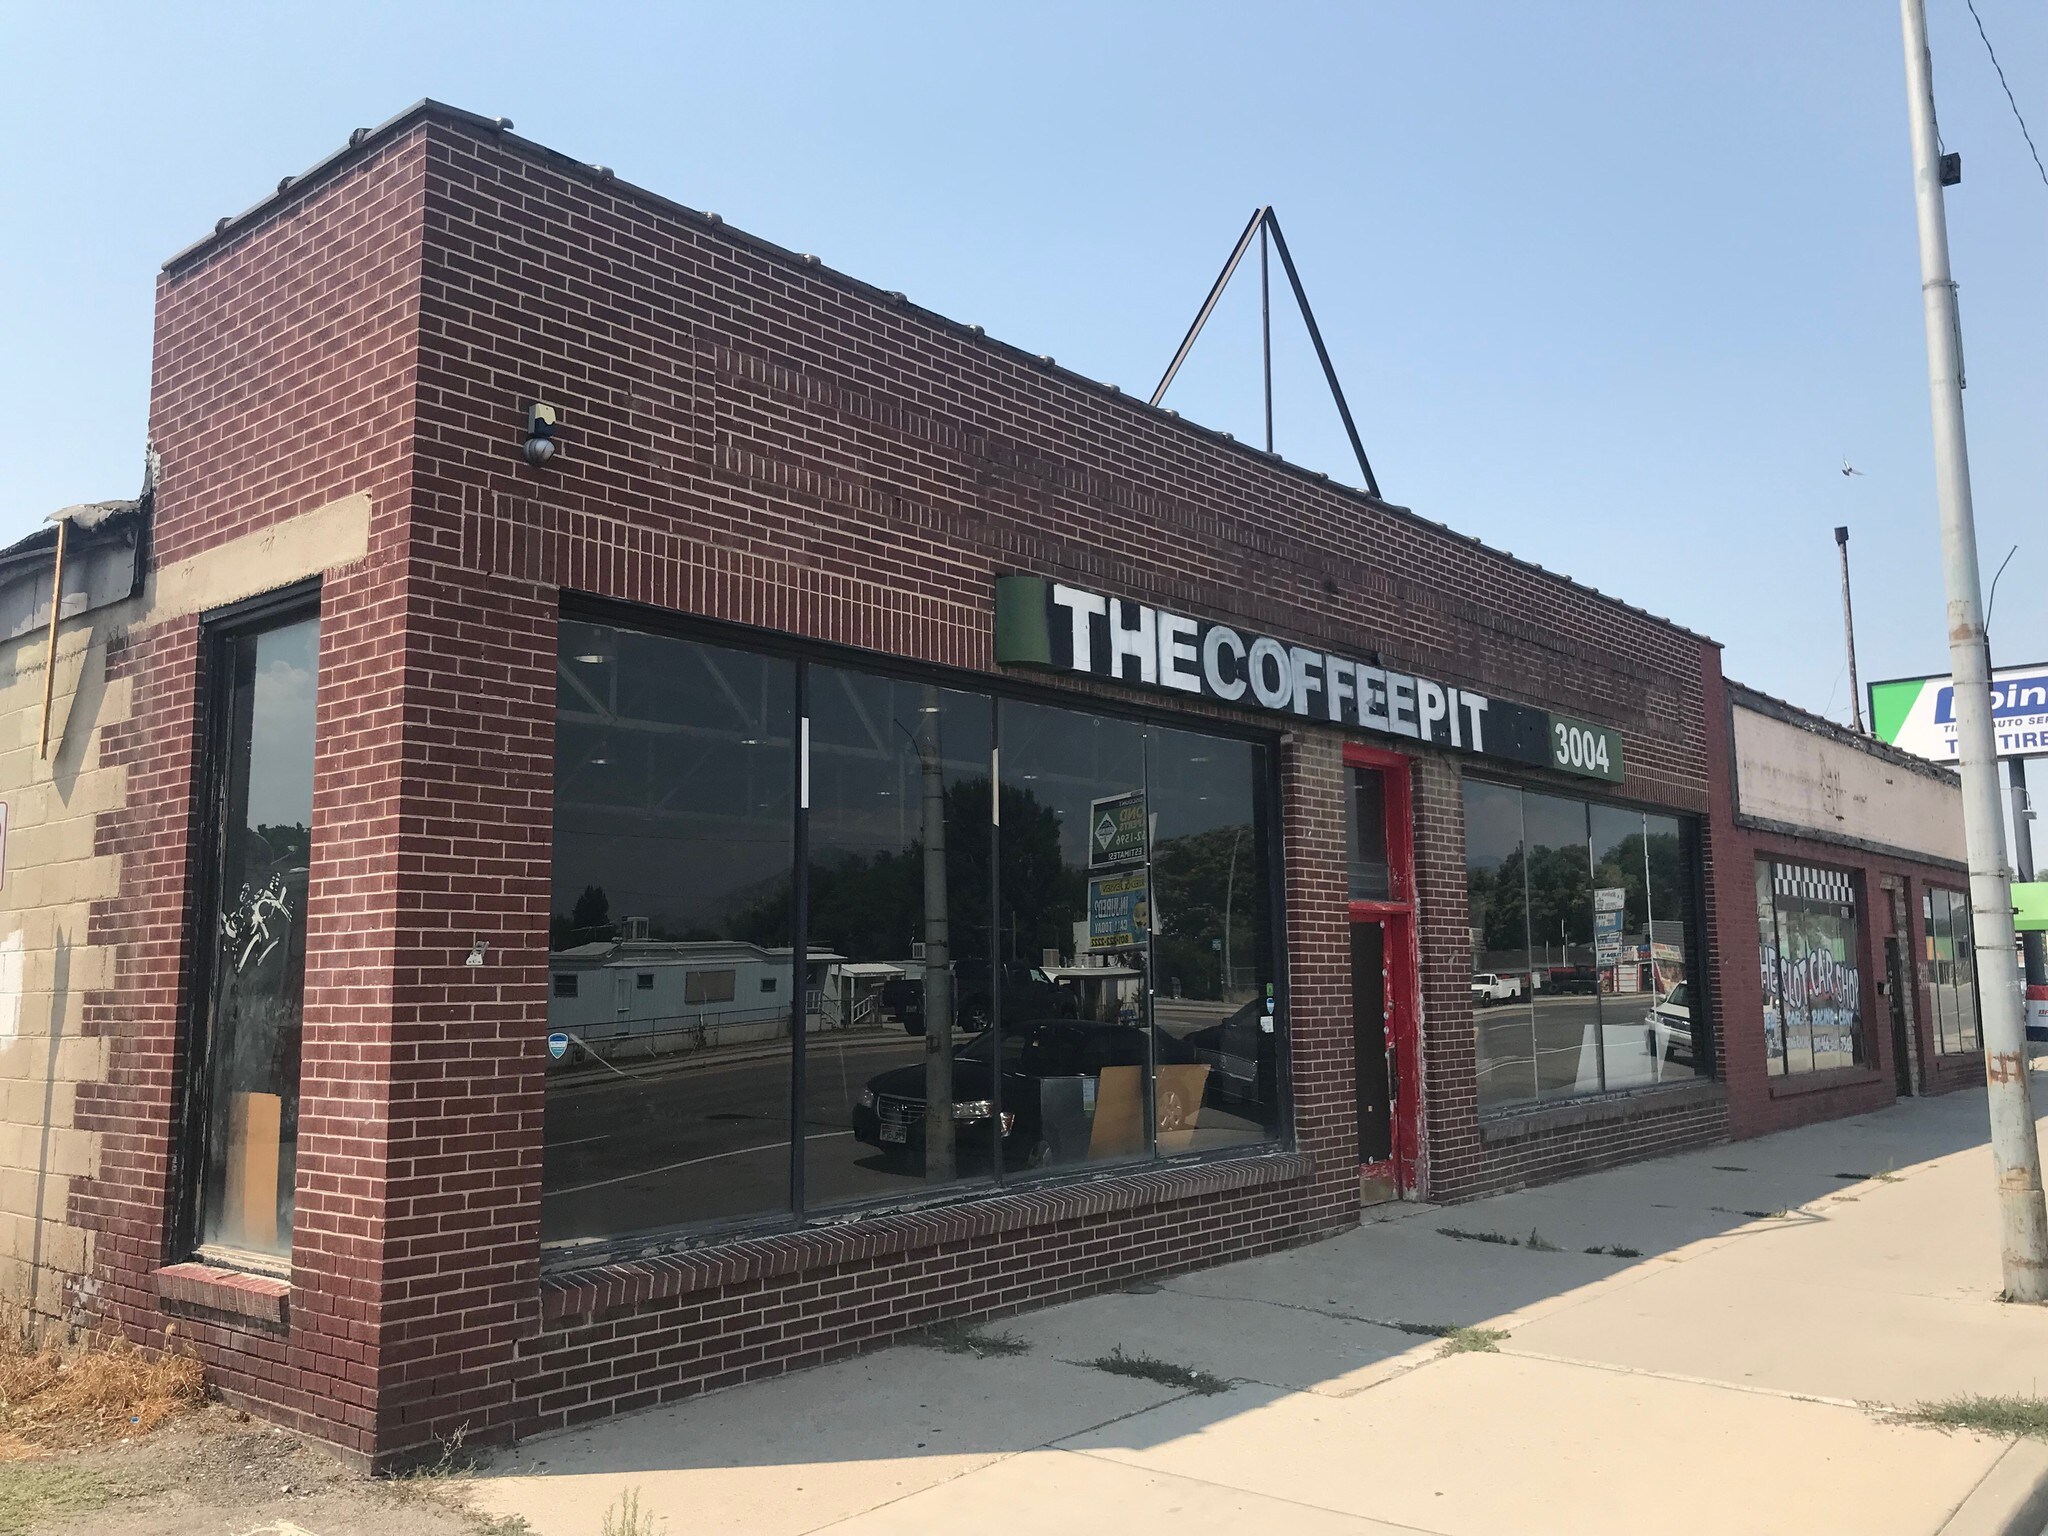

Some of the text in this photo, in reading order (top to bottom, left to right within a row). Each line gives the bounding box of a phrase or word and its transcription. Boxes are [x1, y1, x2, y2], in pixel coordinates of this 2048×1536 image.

[1554, 722, 1610, 774] 3004
[1780, 957, 1808, 1008] SLOT
[1809, 946, 1835, 997] CAR
[1835, 963, 1859, 1011] SHOP
